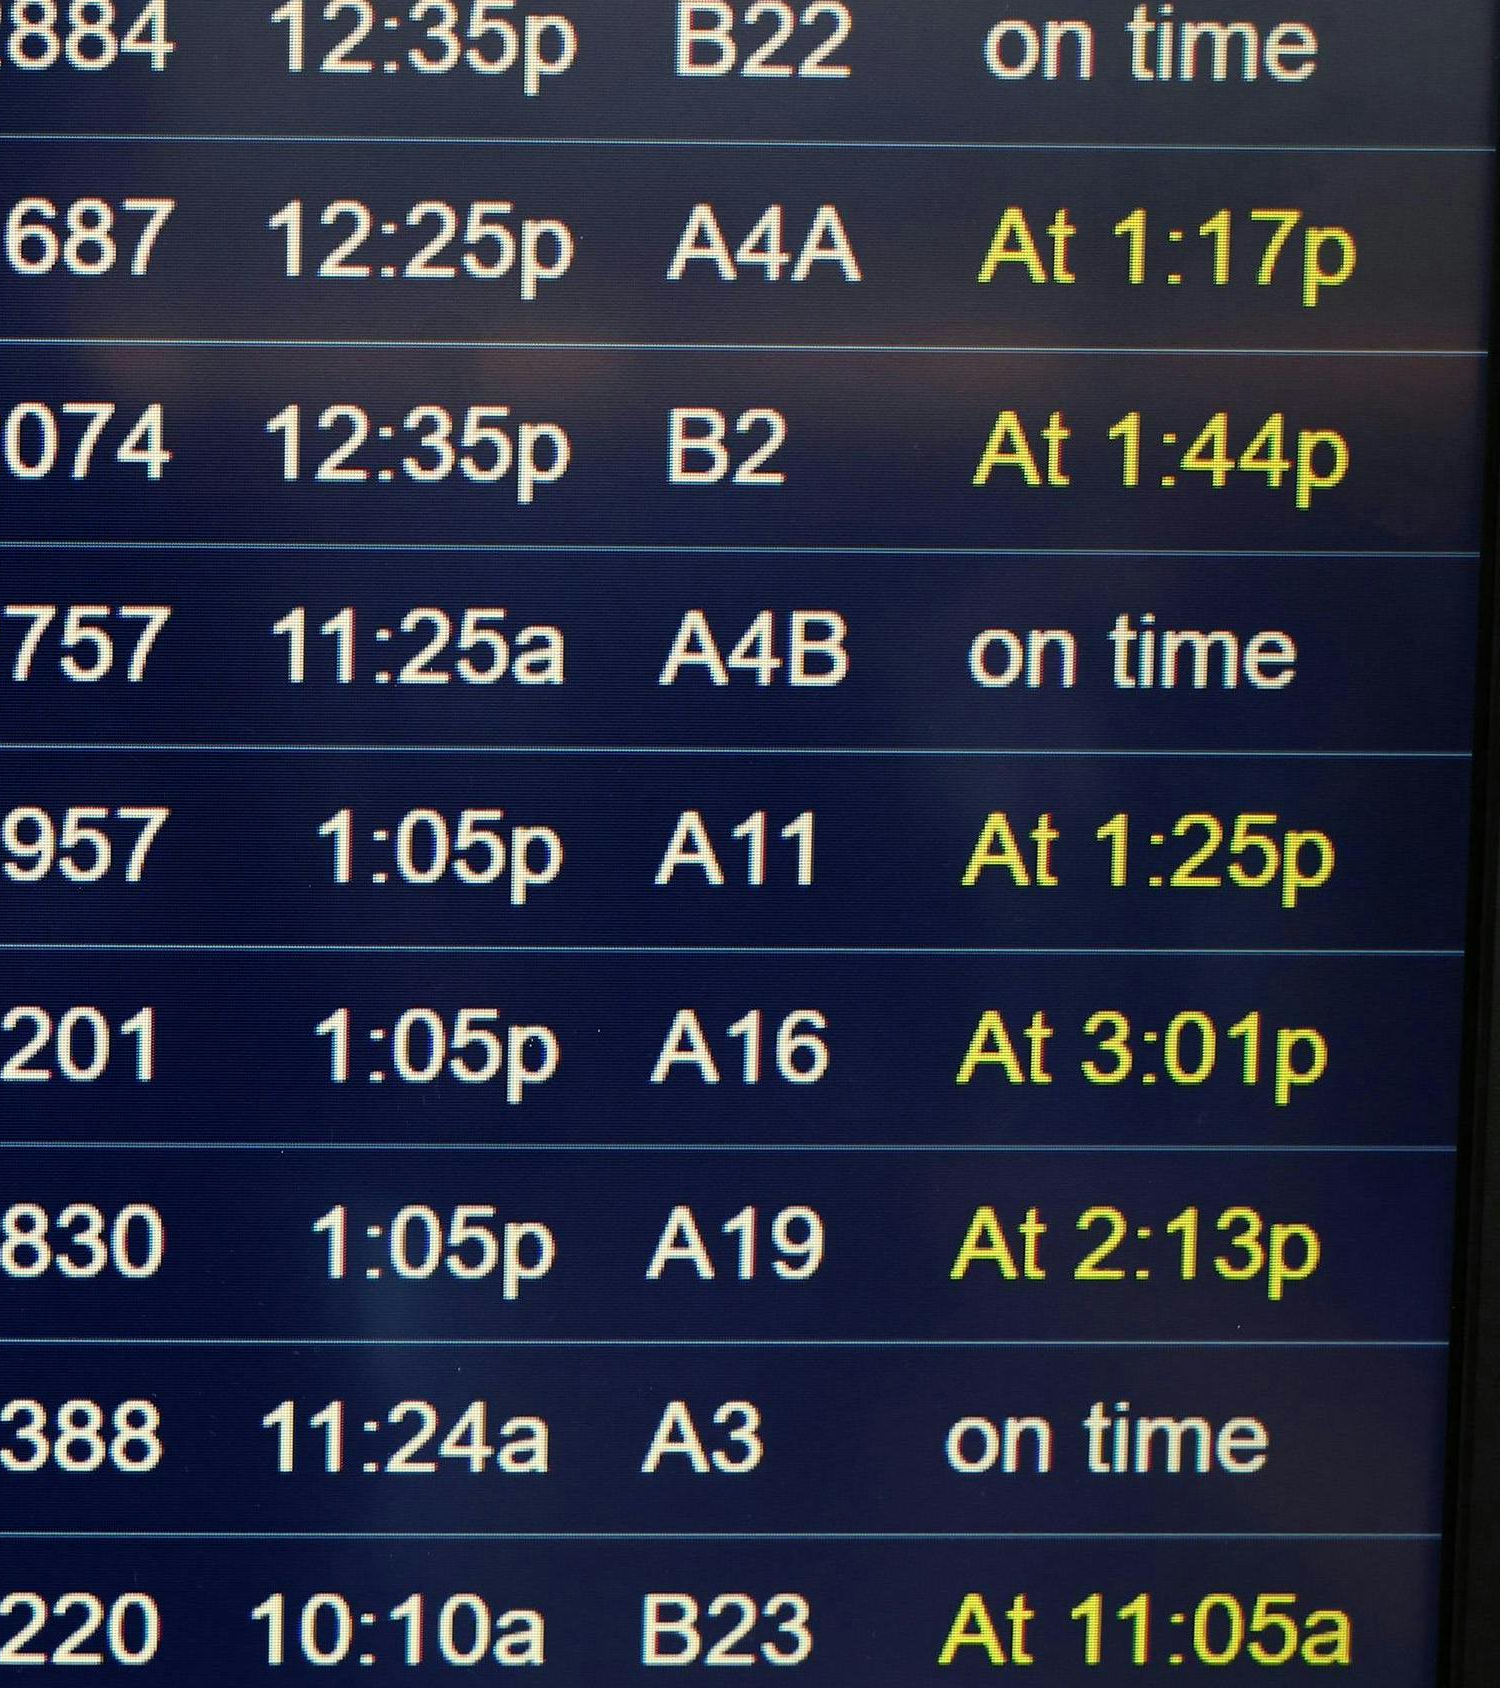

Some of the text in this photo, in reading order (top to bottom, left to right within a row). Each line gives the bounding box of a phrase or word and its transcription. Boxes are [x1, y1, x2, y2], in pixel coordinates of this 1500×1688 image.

[271, 0, 578, 96] 12:35p
[677, 0, 853, 78] B22
[986, 19, 1094, 79] on
[1127, 3, 1318, 81] time
[269, 199, 575, 301] 12:25p
[667, 203, 862, 282] A4A
[978, 206, 1076, 283] At
[1114, 208, 1357, 307] 1:17p
[267, 404, 571, 503] 12:35p
[670, 407, 787, 484] B2
[973, 410, 1071, 486] At
[1109, 411, 1349, 508] 1:44p
[273, 607, 564, 684] 11:25a
[659, 610, 849, 686] A4B
[970, 629, 1076, 687] on
[1110, 613, 1296, 688] time
[320, 808, 564, 905] 1:05p
[655, 810, 813, 885] A11
[963, 811, 1059, 886] At
[1097, 813, 1335, 908] 1:25p
[0, 1006, 153, 1080] 201
[317, 1008, 560, 1104] 1:05p
[651, 1009, 829, 1083] A16
[957, 1010, 1053, 1083] At
[1083, 1010, 1328, 1105] 3:01p
[315, 1205, 556, 1300] 1:05p
[646, 1205, 824, 1279] A19
[951, 1206, 1047, 1279] At
[1075, 1206, 1320, 1300] 2:13p
[0, 1399, 163, 1472] 388
[263, 1400, 549, 1473] 11:24a
[642, 1400, 763, 1473] A3
[947, 1417, 1052, 1473] on
[1085, 1401, 1269, 1473] time
[252, 1593, 544, 1665] 10:10a
[644, 1593, 813, 1665] B23
[939, 1593, 1034, 1664] At
[1071, 1593, 1351, 1664] 11:05a
